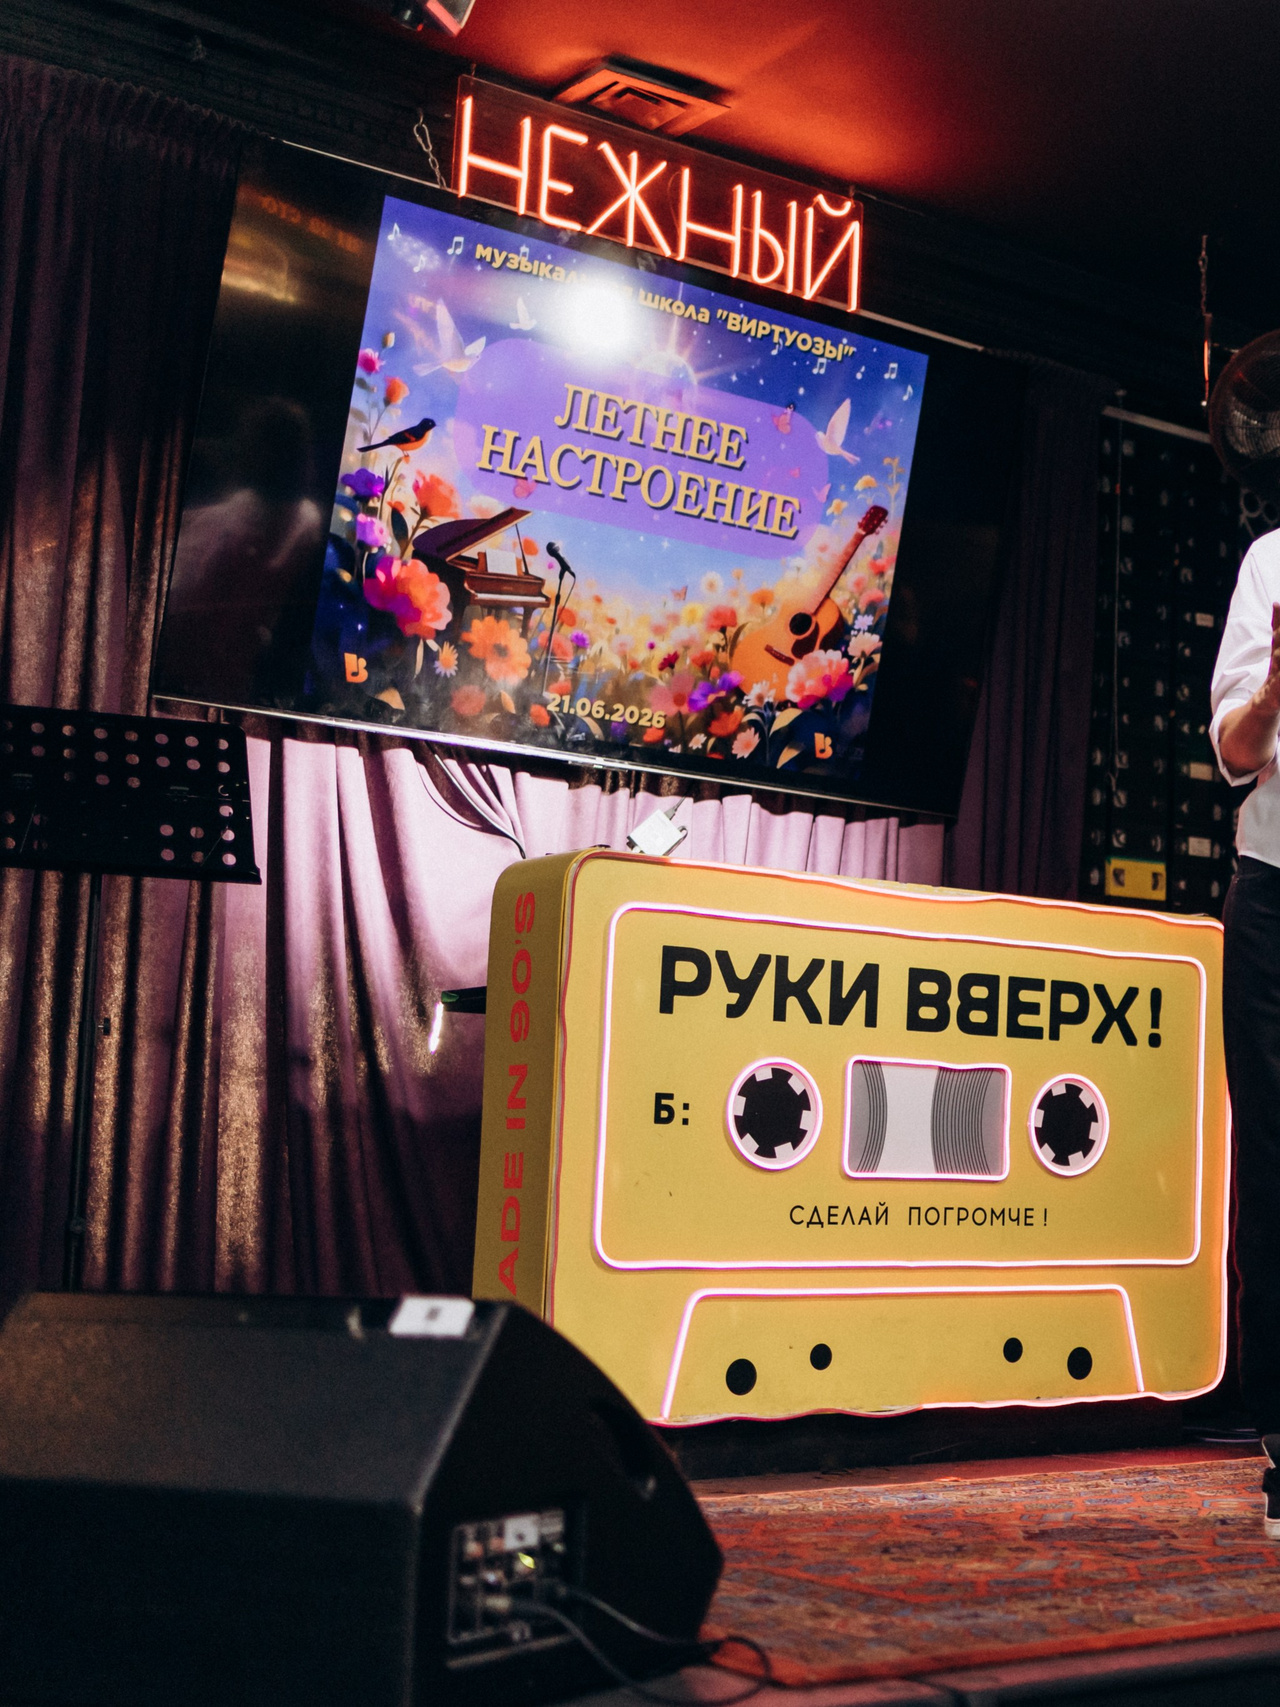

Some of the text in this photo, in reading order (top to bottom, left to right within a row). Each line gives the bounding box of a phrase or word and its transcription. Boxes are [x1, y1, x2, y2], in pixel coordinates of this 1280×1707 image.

[459, 95, 862, 312] НЕЖНЫЙ
[475, 243, 855, 362] музыкалья школа "ВИРТУОЗЫ"
[555, 383, 749, 470] ЛЕТНЕЕ
[477, 425, 801, 540] НАСТРОЕНИЕ
[546, 693, 667, 729] 21.06.2026
[659, 945, 1162, 1048] РУКИ ВВЕРХ!
[497, 891, 534, 1296] ADE IN 90'S
[653, 1092, 691, 1126] Б:
[788, 1201, 889, 1229] СДЕЛАЙ
